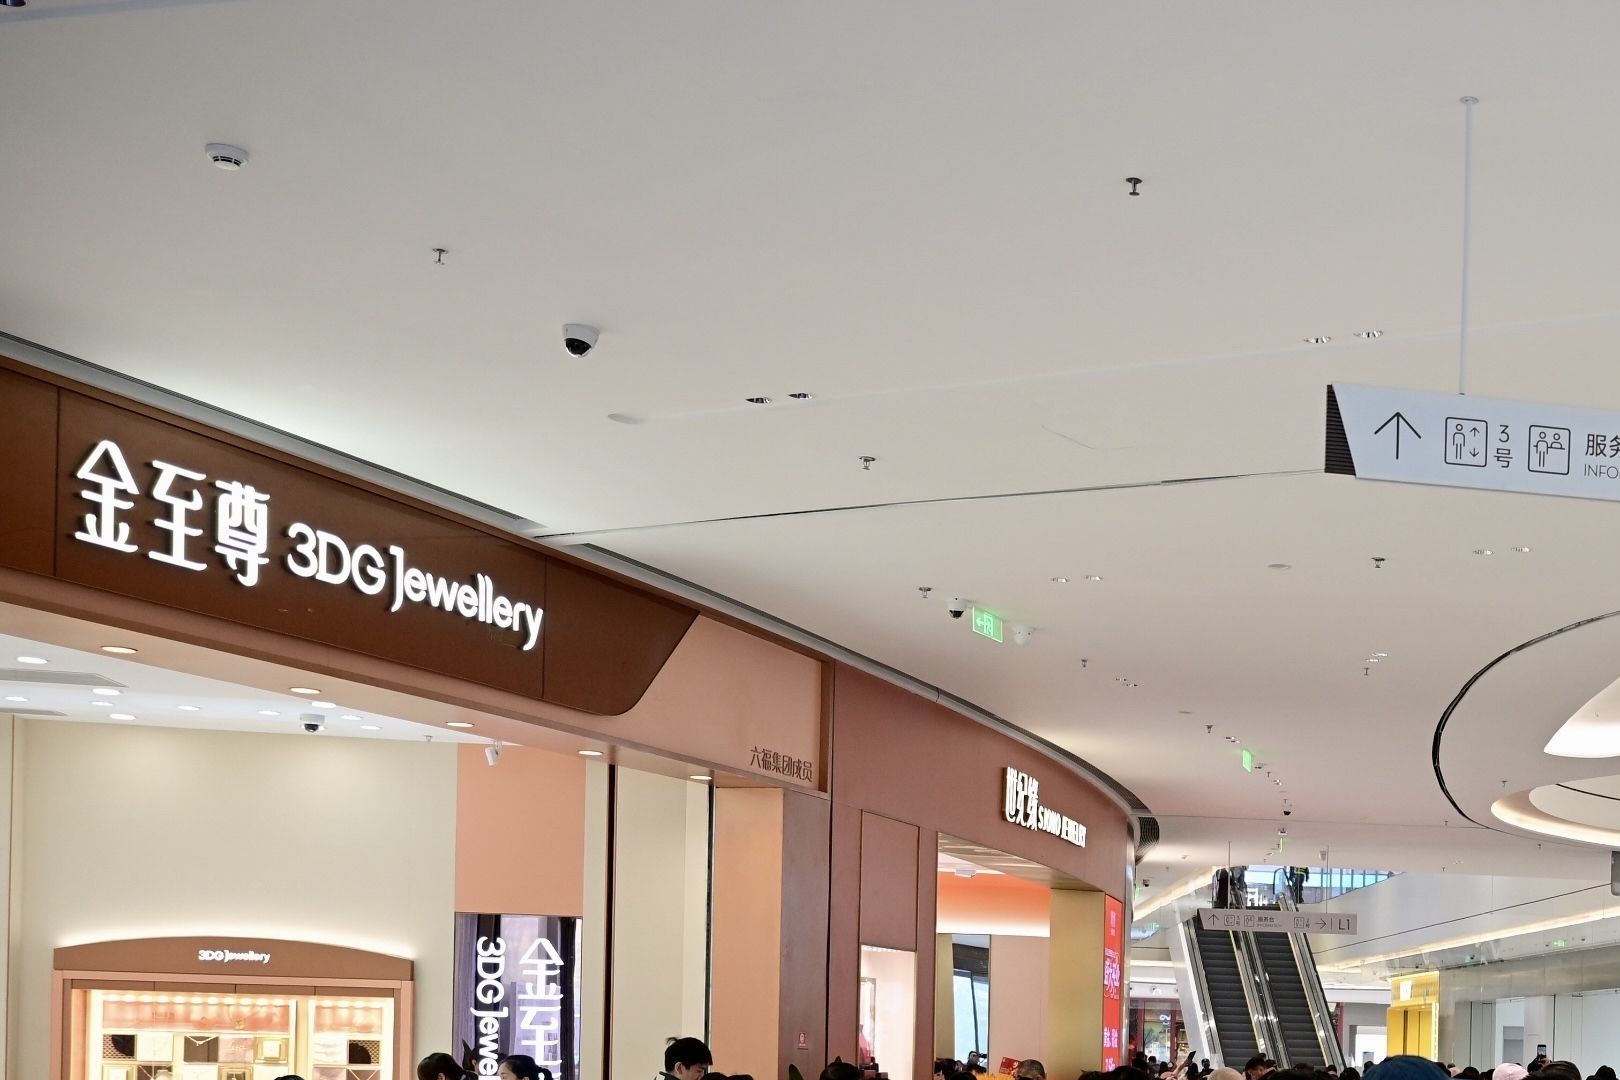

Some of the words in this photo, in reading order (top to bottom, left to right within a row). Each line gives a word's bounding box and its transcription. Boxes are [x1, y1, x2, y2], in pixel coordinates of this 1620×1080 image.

[74, 439, 272, 588] 金至尊
[286, 522, 388, 597] 3DG
[389, 545, 545, 652] Jewellery
[749, 745, 813, 783] 六福集团成员
[1338, 918, 1350, 931] L1
[198, 949, 225, 961] 3DG
[477, 936, 507, 1005] 3DG
